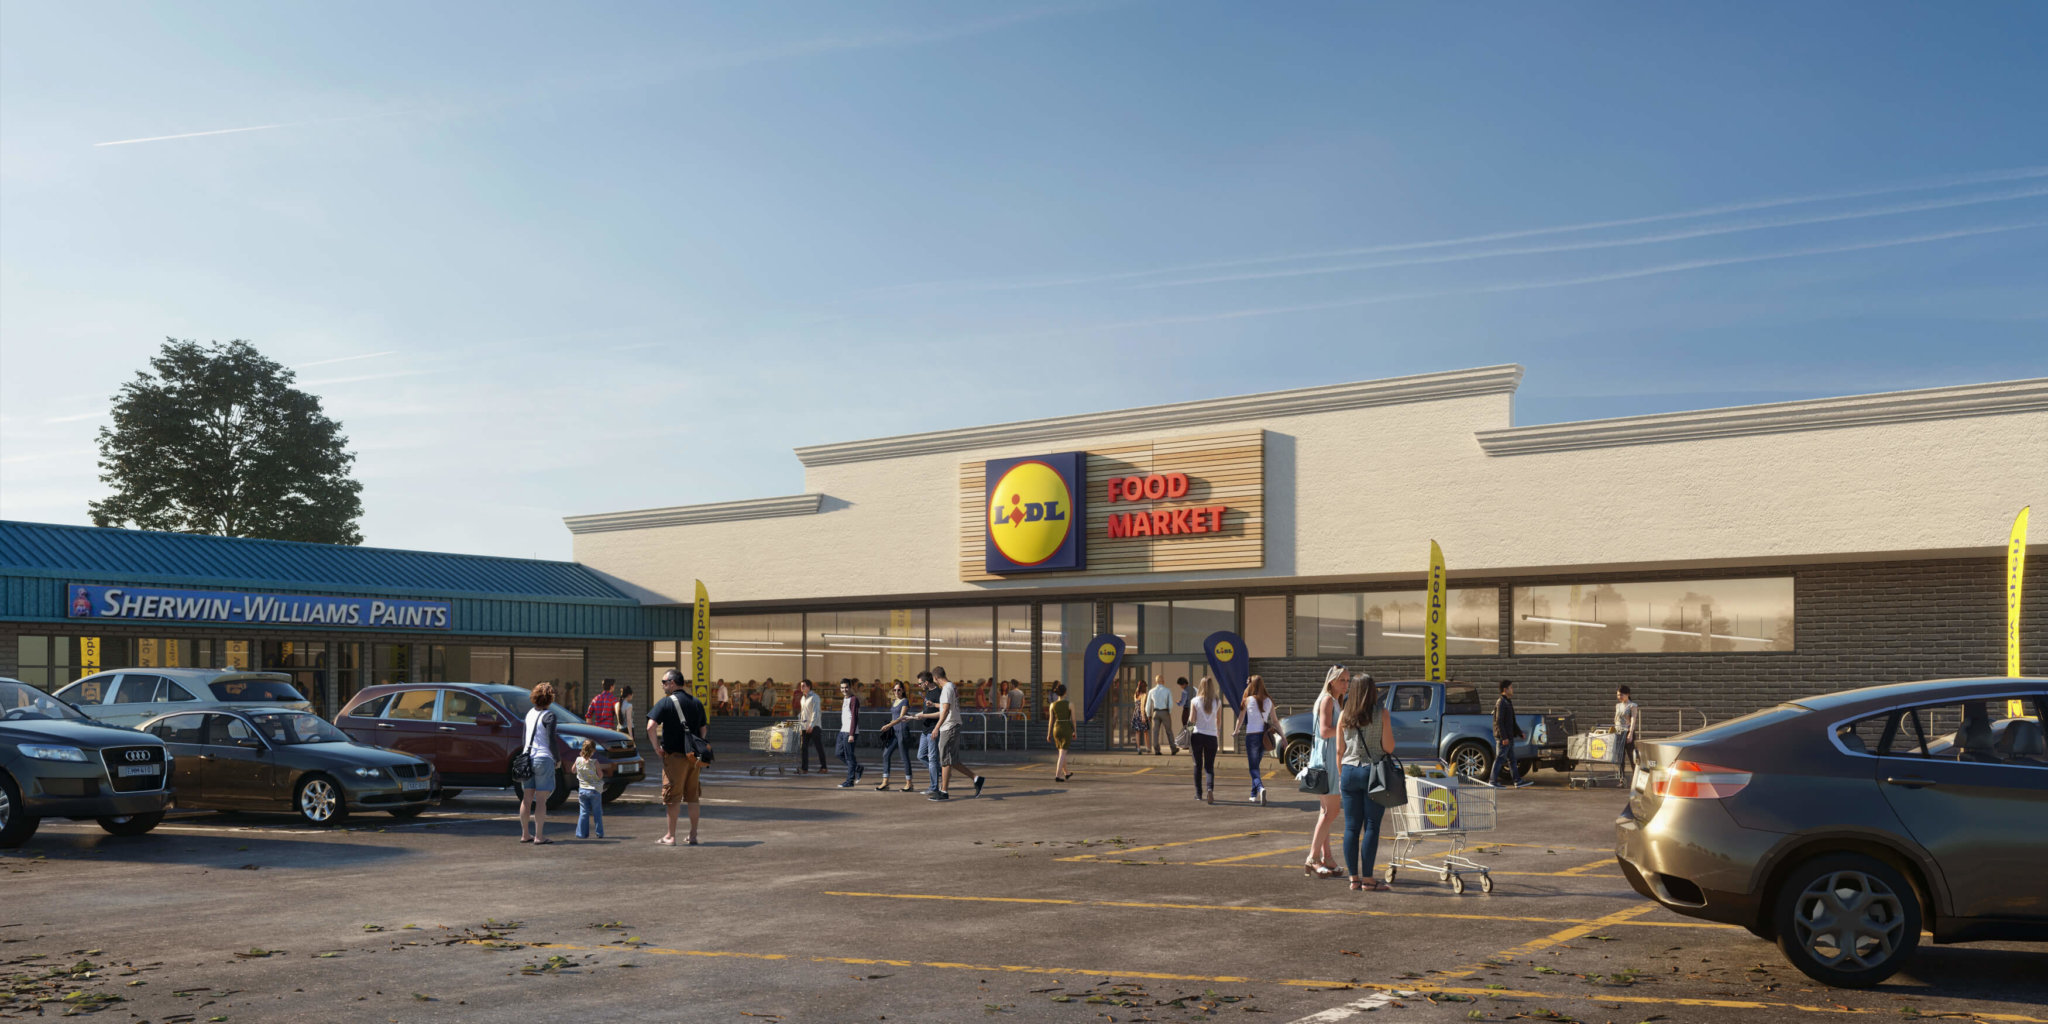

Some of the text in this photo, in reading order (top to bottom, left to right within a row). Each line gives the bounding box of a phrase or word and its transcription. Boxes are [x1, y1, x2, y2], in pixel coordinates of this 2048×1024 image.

[1107, 472, 1190, 503] FOOD
[1107, 505, 1227, 539] MARKET
[100, 589, 447, 627] SHERWIN-WILLIAMS PAINTS
[1431, 565, 1441, 681] now open
[697, 598, 705, 682] now open
